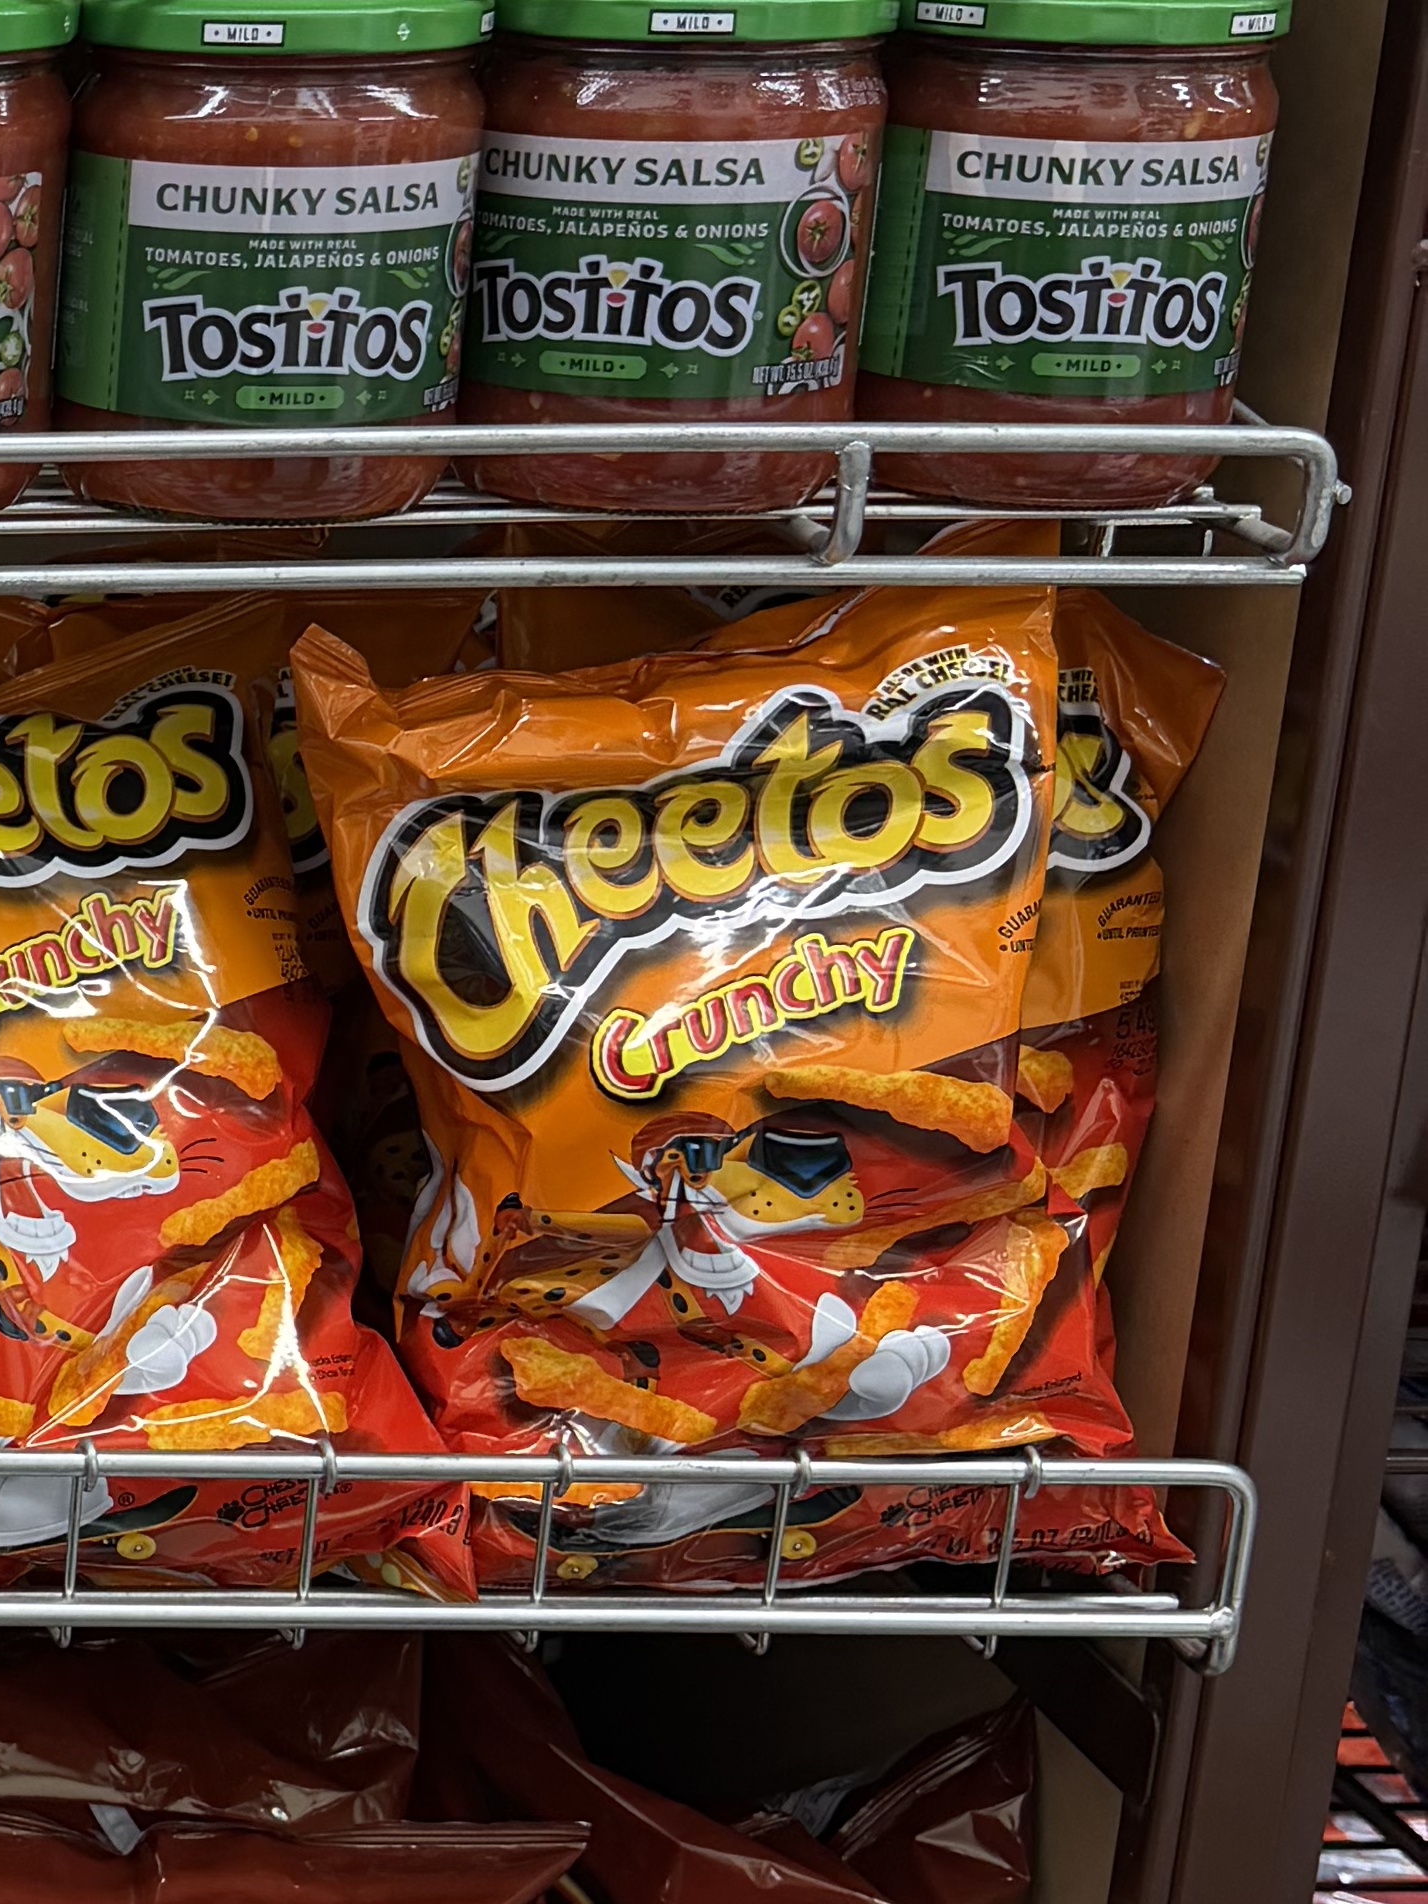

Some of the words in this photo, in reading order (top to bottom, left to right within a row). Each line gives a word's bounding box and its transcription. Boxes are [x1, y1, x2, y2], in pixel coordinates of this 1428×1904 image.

[677, 14, 710, 31] MILD
[956, 149, 1133, 185] CHUNKY
[1140, 156, 1240, 187] SALSA
[156, 183, 327, 216] CHUNKY
[334, 181, 438, 216] SALSA
[145, 246, 247, 269] TOMATOES,
[254, 248, 365, 268] JALAPEÑOS
[370, 251, 382, 266] &
[386, 246, 439, 265] ONIONS
[1066, 356, 1111, 374] MILD
[269, 390, 316, 407] MILD
[358, 683, 1029, 1092] Cheetos
[591, 928, 911, 1101] Crunchy
